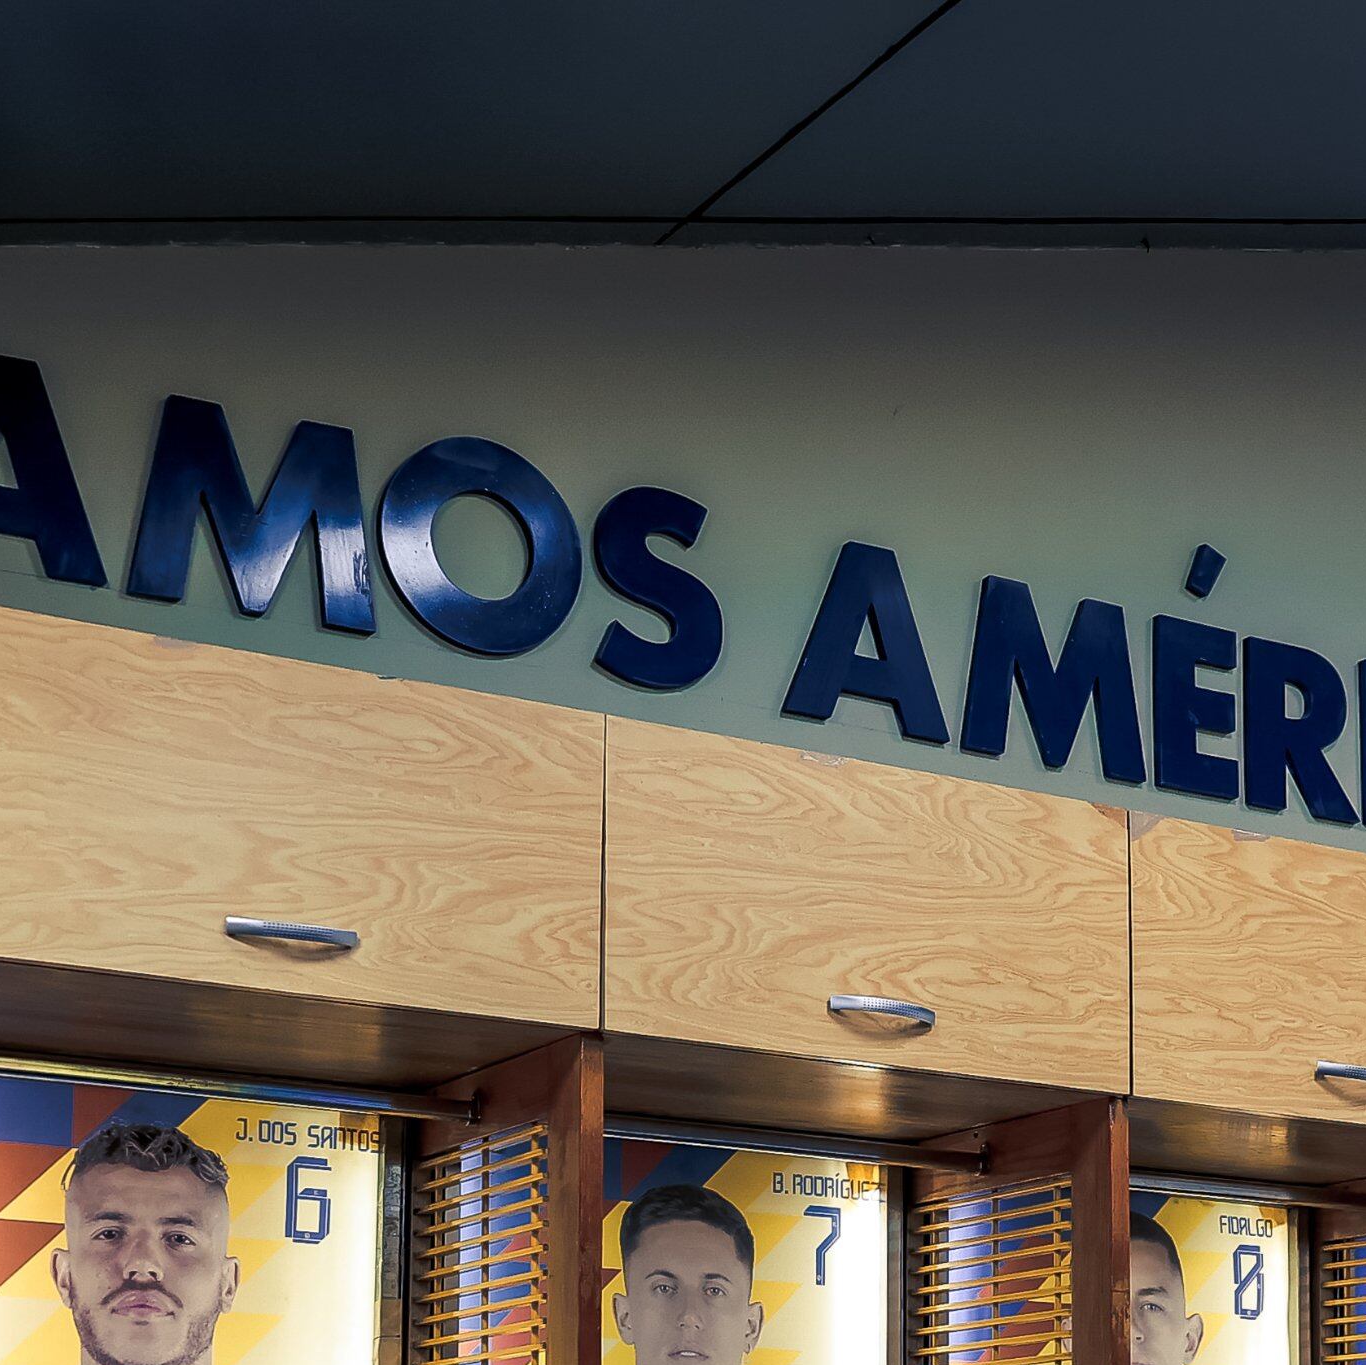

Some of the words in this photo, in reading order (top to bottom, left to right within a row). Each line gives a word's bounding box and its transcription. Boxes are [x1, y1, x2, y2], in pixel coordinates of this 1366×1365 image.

[235, 1117, 254, 1142] J.
[258, 1119, 297, 1146] DOS
[307, 1124, 381, 1154] SANTOS
[284, 1155, 332, 1245] 6
[772, 1171, 789, 1195] B.
[803, 1204, 841, 1286] 7
[1219, 1214, 1273, 1239] FIDALGO
[1232, 1244, 1265, 1321] 8
